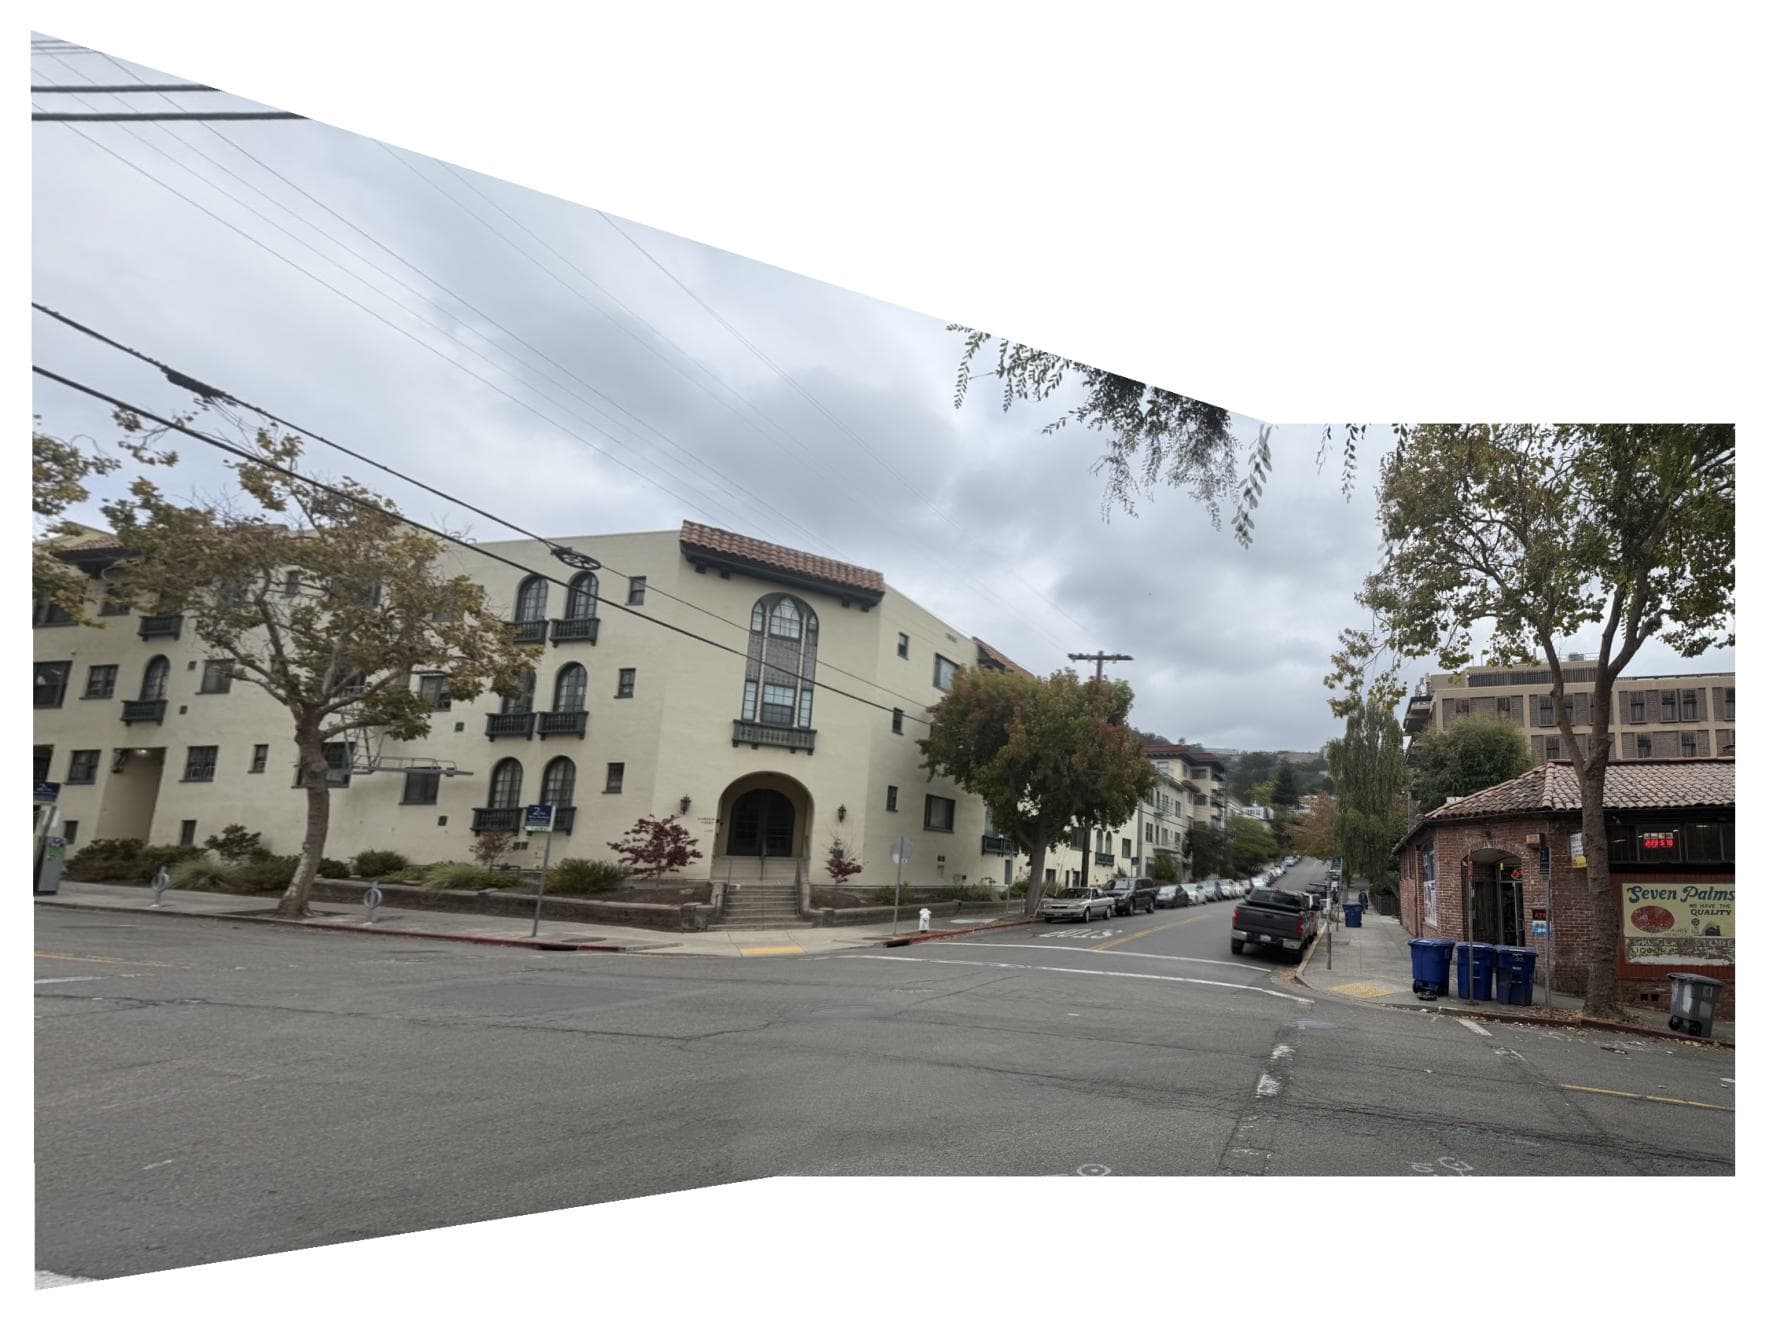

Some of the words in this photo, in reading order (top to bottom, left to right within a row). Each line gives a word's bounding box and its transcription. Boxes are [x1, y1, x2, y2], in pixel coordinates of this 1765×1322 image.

[1627, 885, 1677, 903] Seven
[1680, 885, 1735, 903] Palms
[1690, 908, 1732, 917] QUALITY
